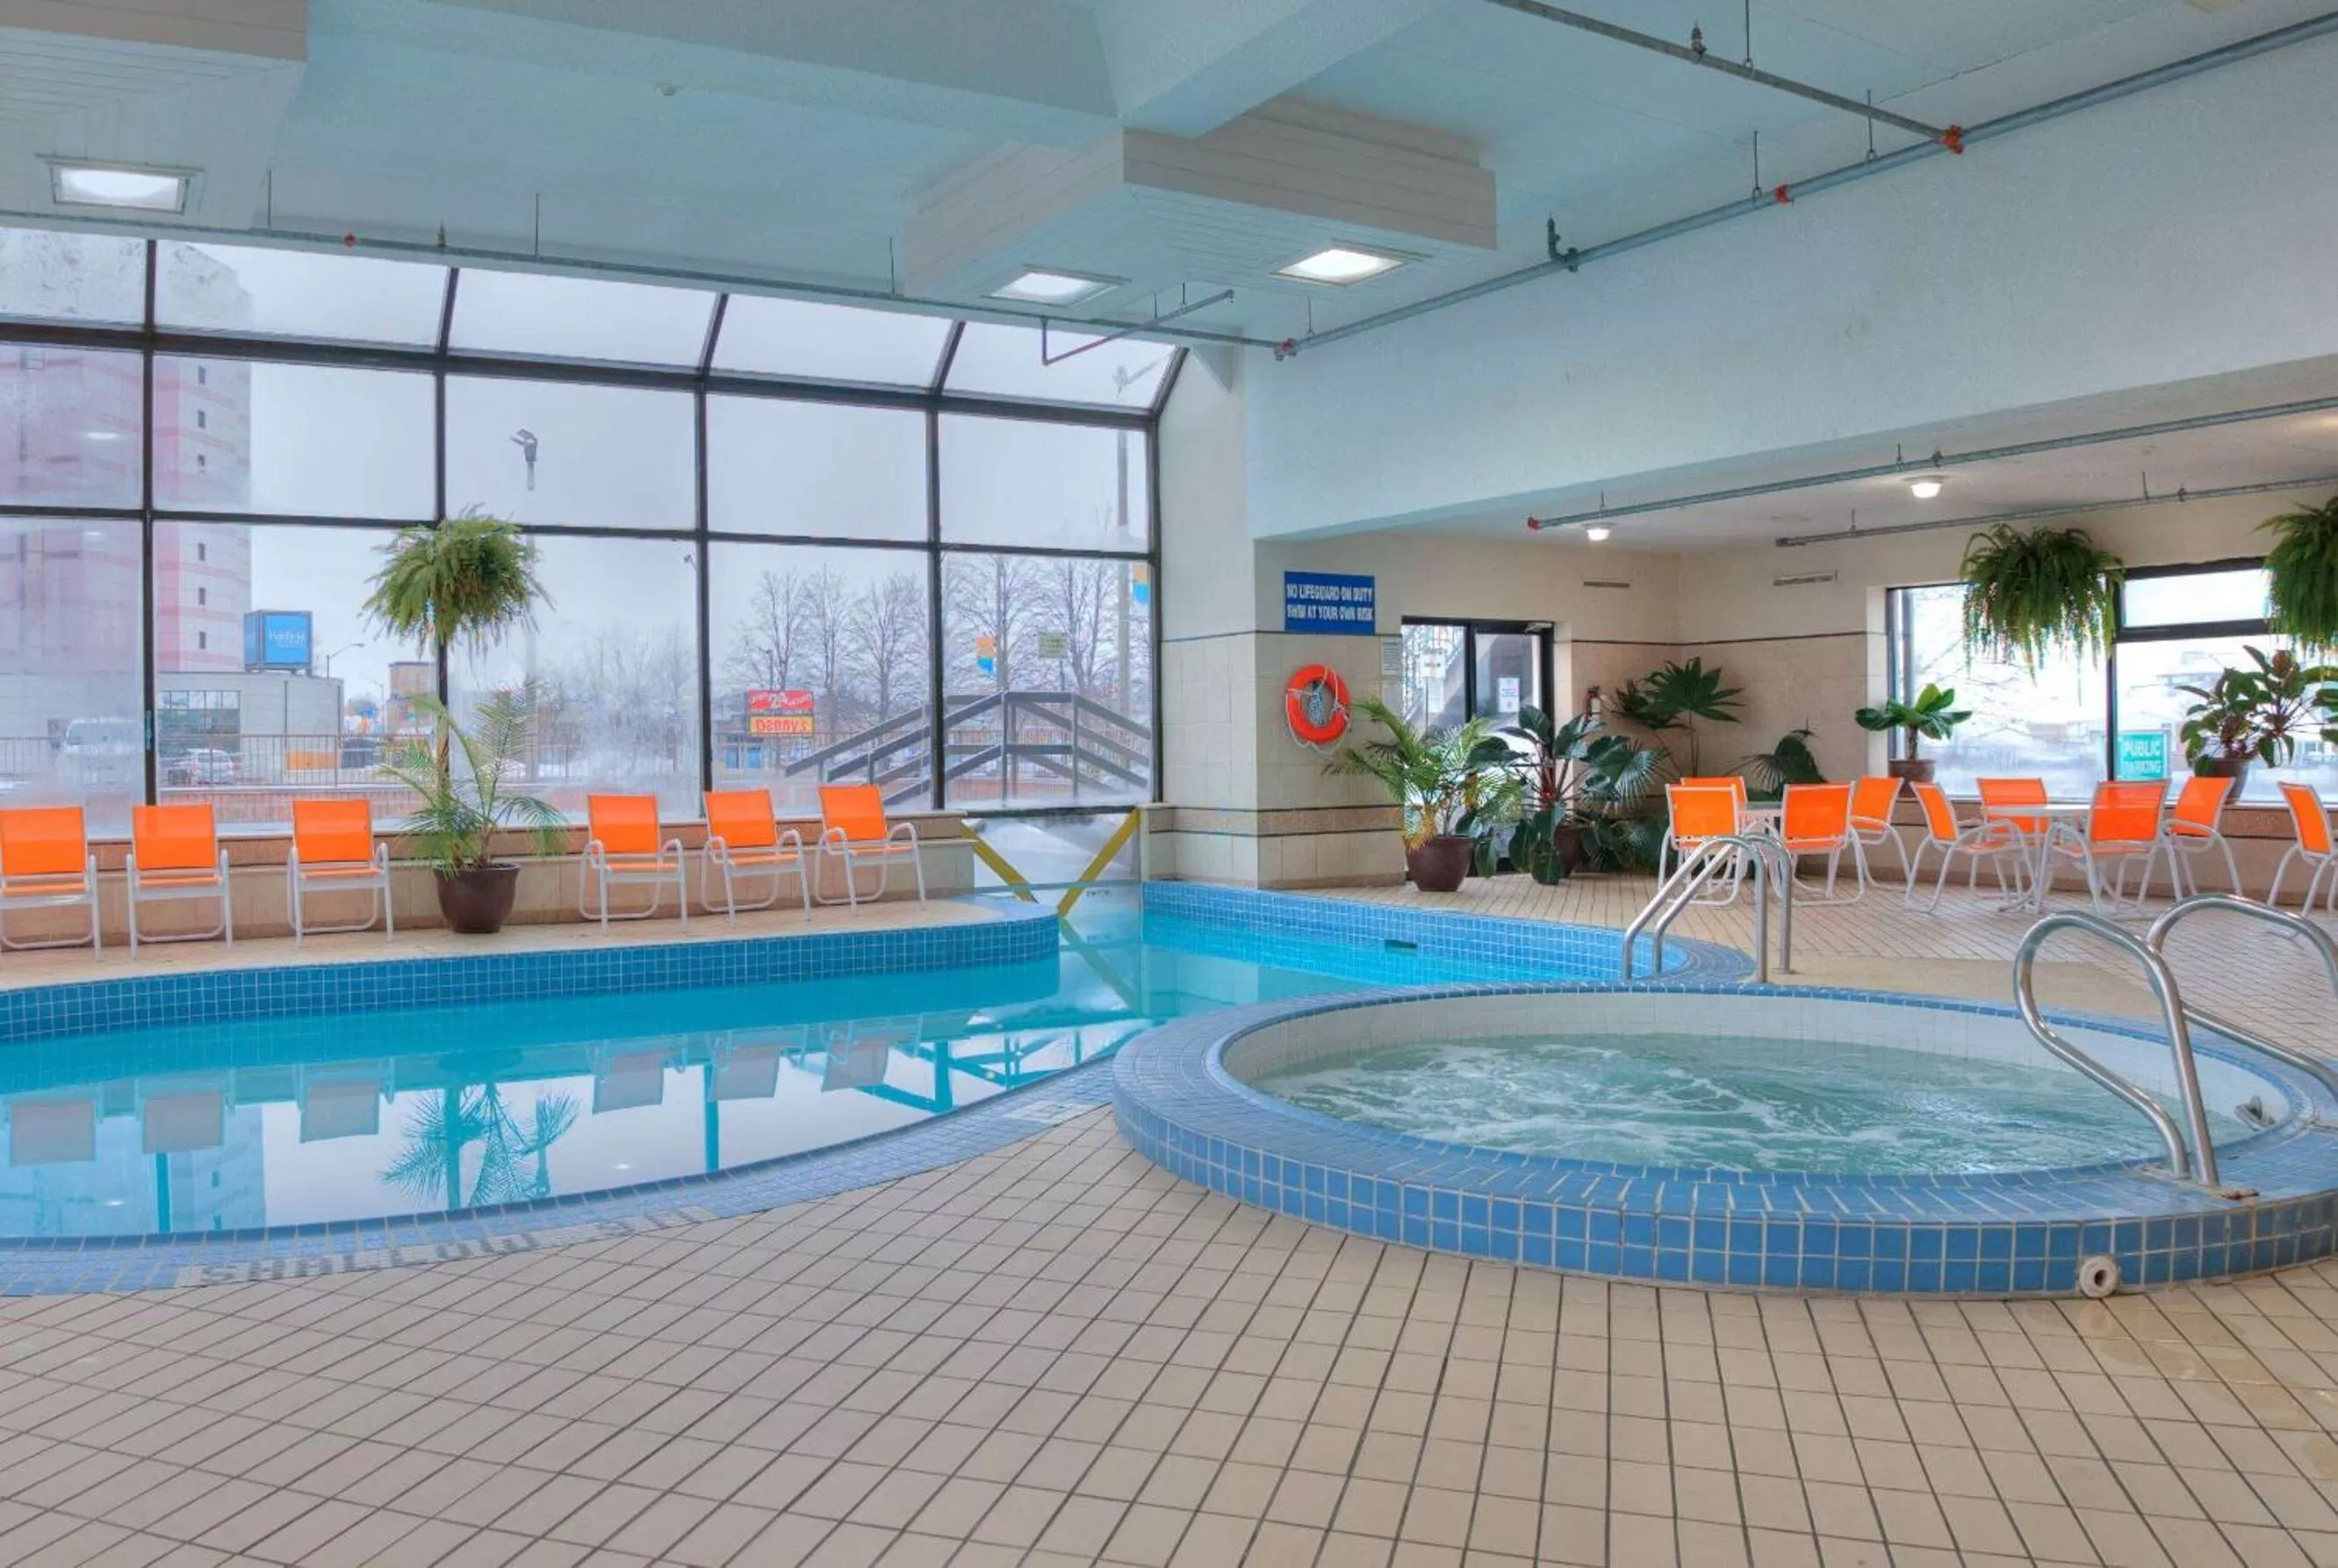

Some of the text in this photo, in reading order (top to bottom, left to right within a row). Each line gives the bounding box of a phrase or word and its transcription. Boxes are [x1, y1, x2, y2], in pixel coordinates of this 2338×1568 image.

[1286, 583, 1372, 602] NO LIFEGUARD ON DUTY
[1286, 604, 1306, 618] SWIM
[1307, 605, 1318, 619] AT
[1319, 605, 1338, 620] YOUR
[1340, 606, 1356, 621] OWN
[2123, 739, 2162, 756] PUBLIC
